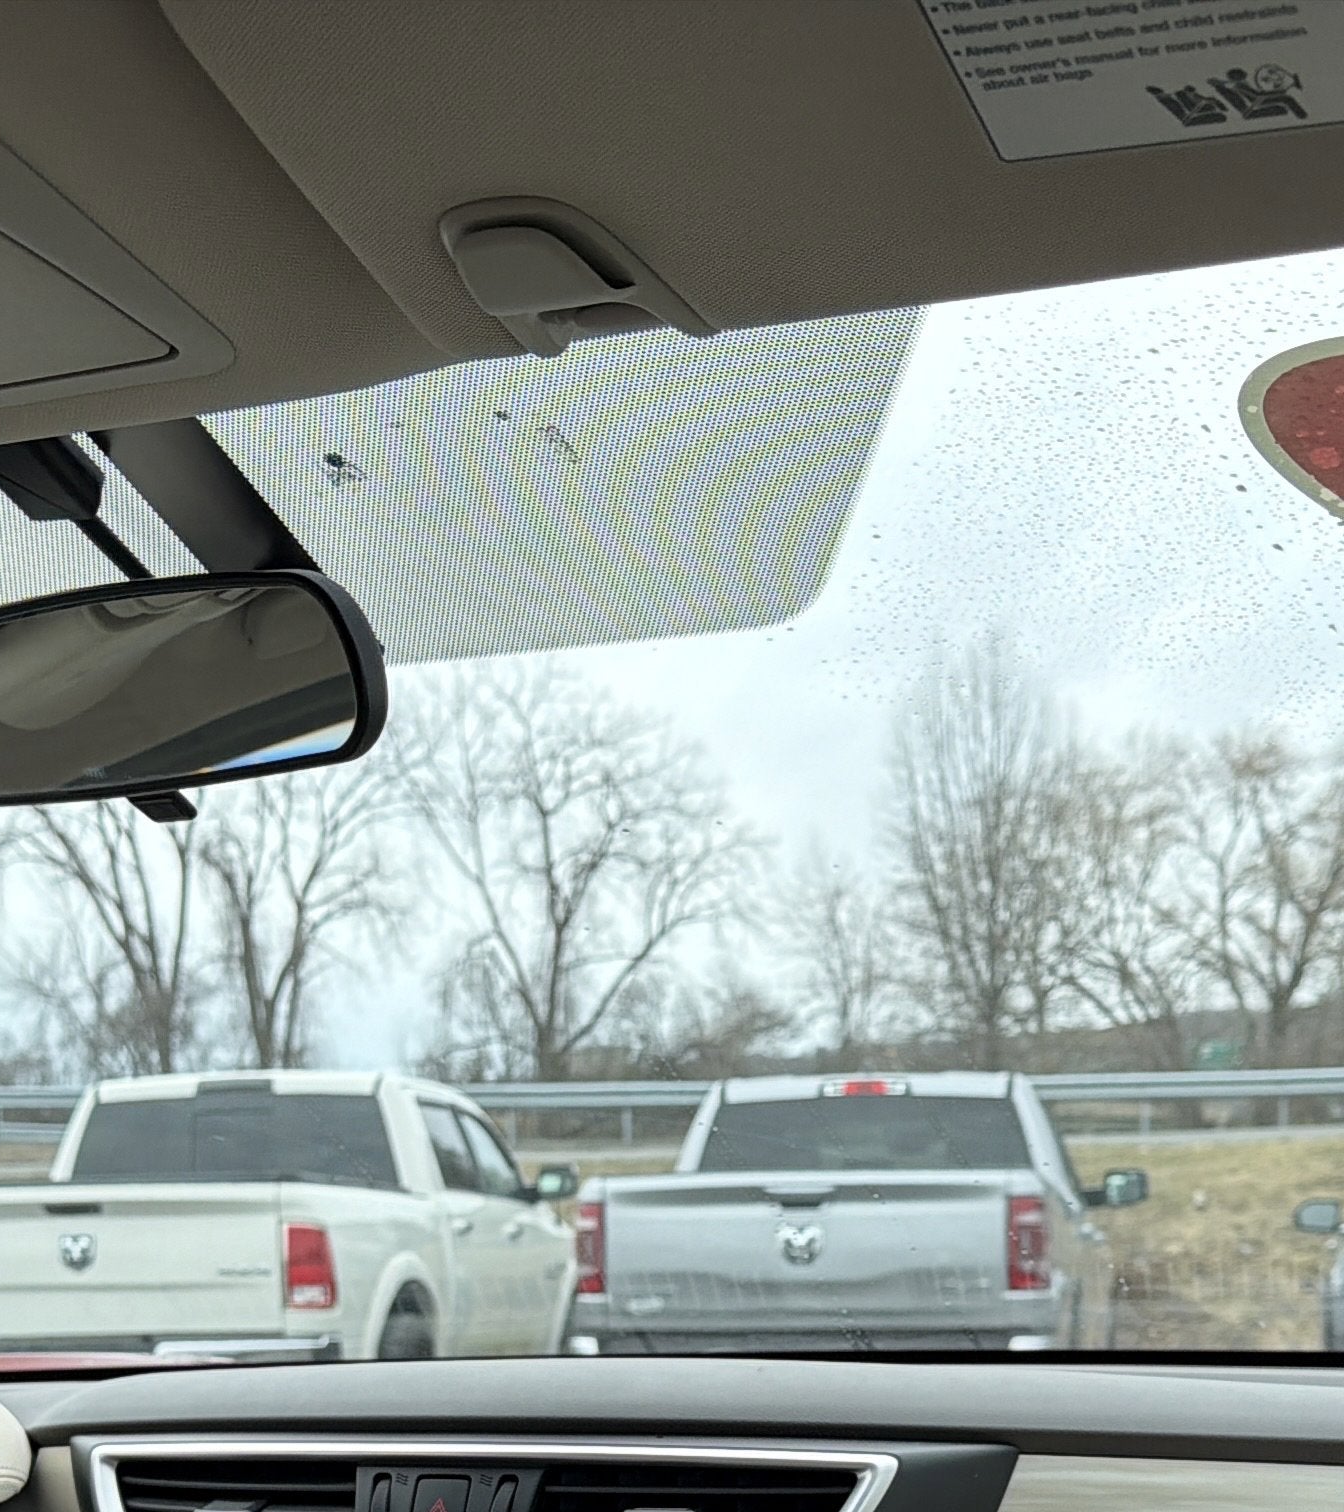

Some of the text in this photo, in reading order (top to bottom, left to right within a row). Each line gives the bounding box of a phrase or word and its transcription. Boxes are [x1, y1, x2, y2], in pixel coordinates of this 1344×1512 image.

[952, 21, 999, 35] Never
[1002, 15, 1030, 31] put
[1033, 15, 1046, 25] a
[965, 41, 1021, 58] Always
[1023, 38, 1054, 49] use
[1056, 31, 1092, 45] seat
[1094, 26, 1136, 40] belts
[1139, 19, 1170, 34] and
[1174, 14, 1215, 29] child
[975, 66, 1006, 79] See
[1009, 57, 1072, 73] owner's
[1074, 48, 1134, 65] manual
[1138, 46, 1160, 56] for
[1165, 40, 1208, 53] more
[982, 69, 1094, 92] about air bags
